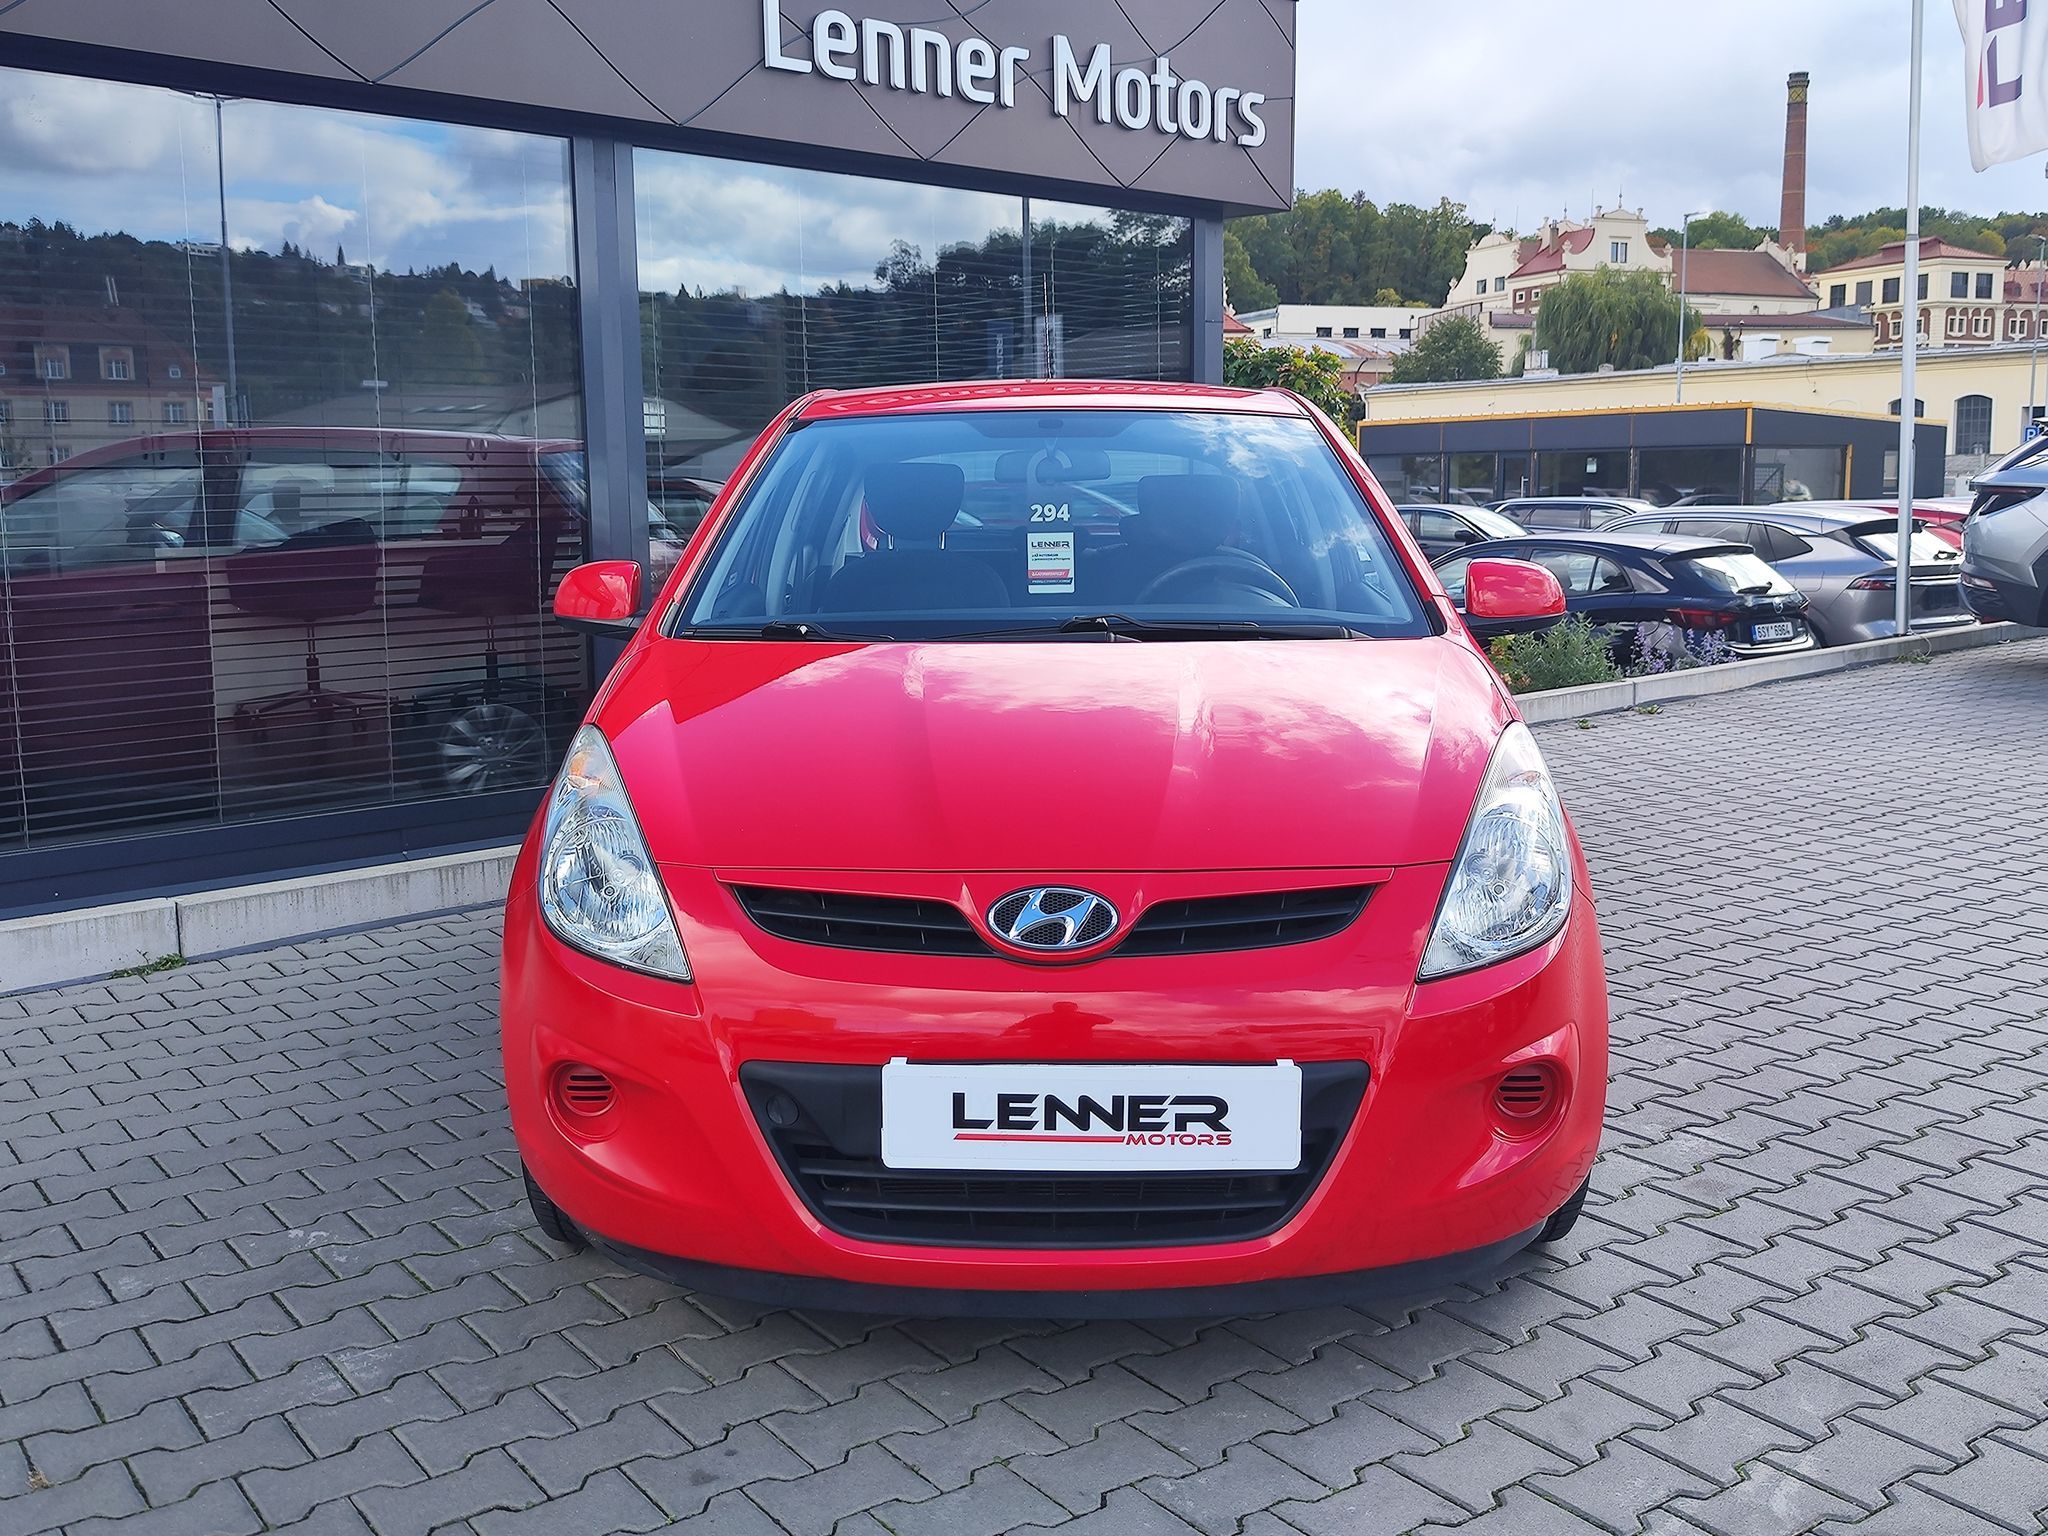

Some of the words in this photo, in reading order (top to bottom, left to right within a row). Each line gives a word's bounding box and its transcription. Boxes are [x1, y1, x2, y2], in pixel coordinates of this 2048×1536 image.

[763, 0, 1031, 108] Lenner
[1052, 34, 1267, 147] Motors
[1030, 503, 1070, 522] 294
[952, 1092, 1232, 1132] LENNER
[1126, 1133, 1232, 1146] MOTORS
